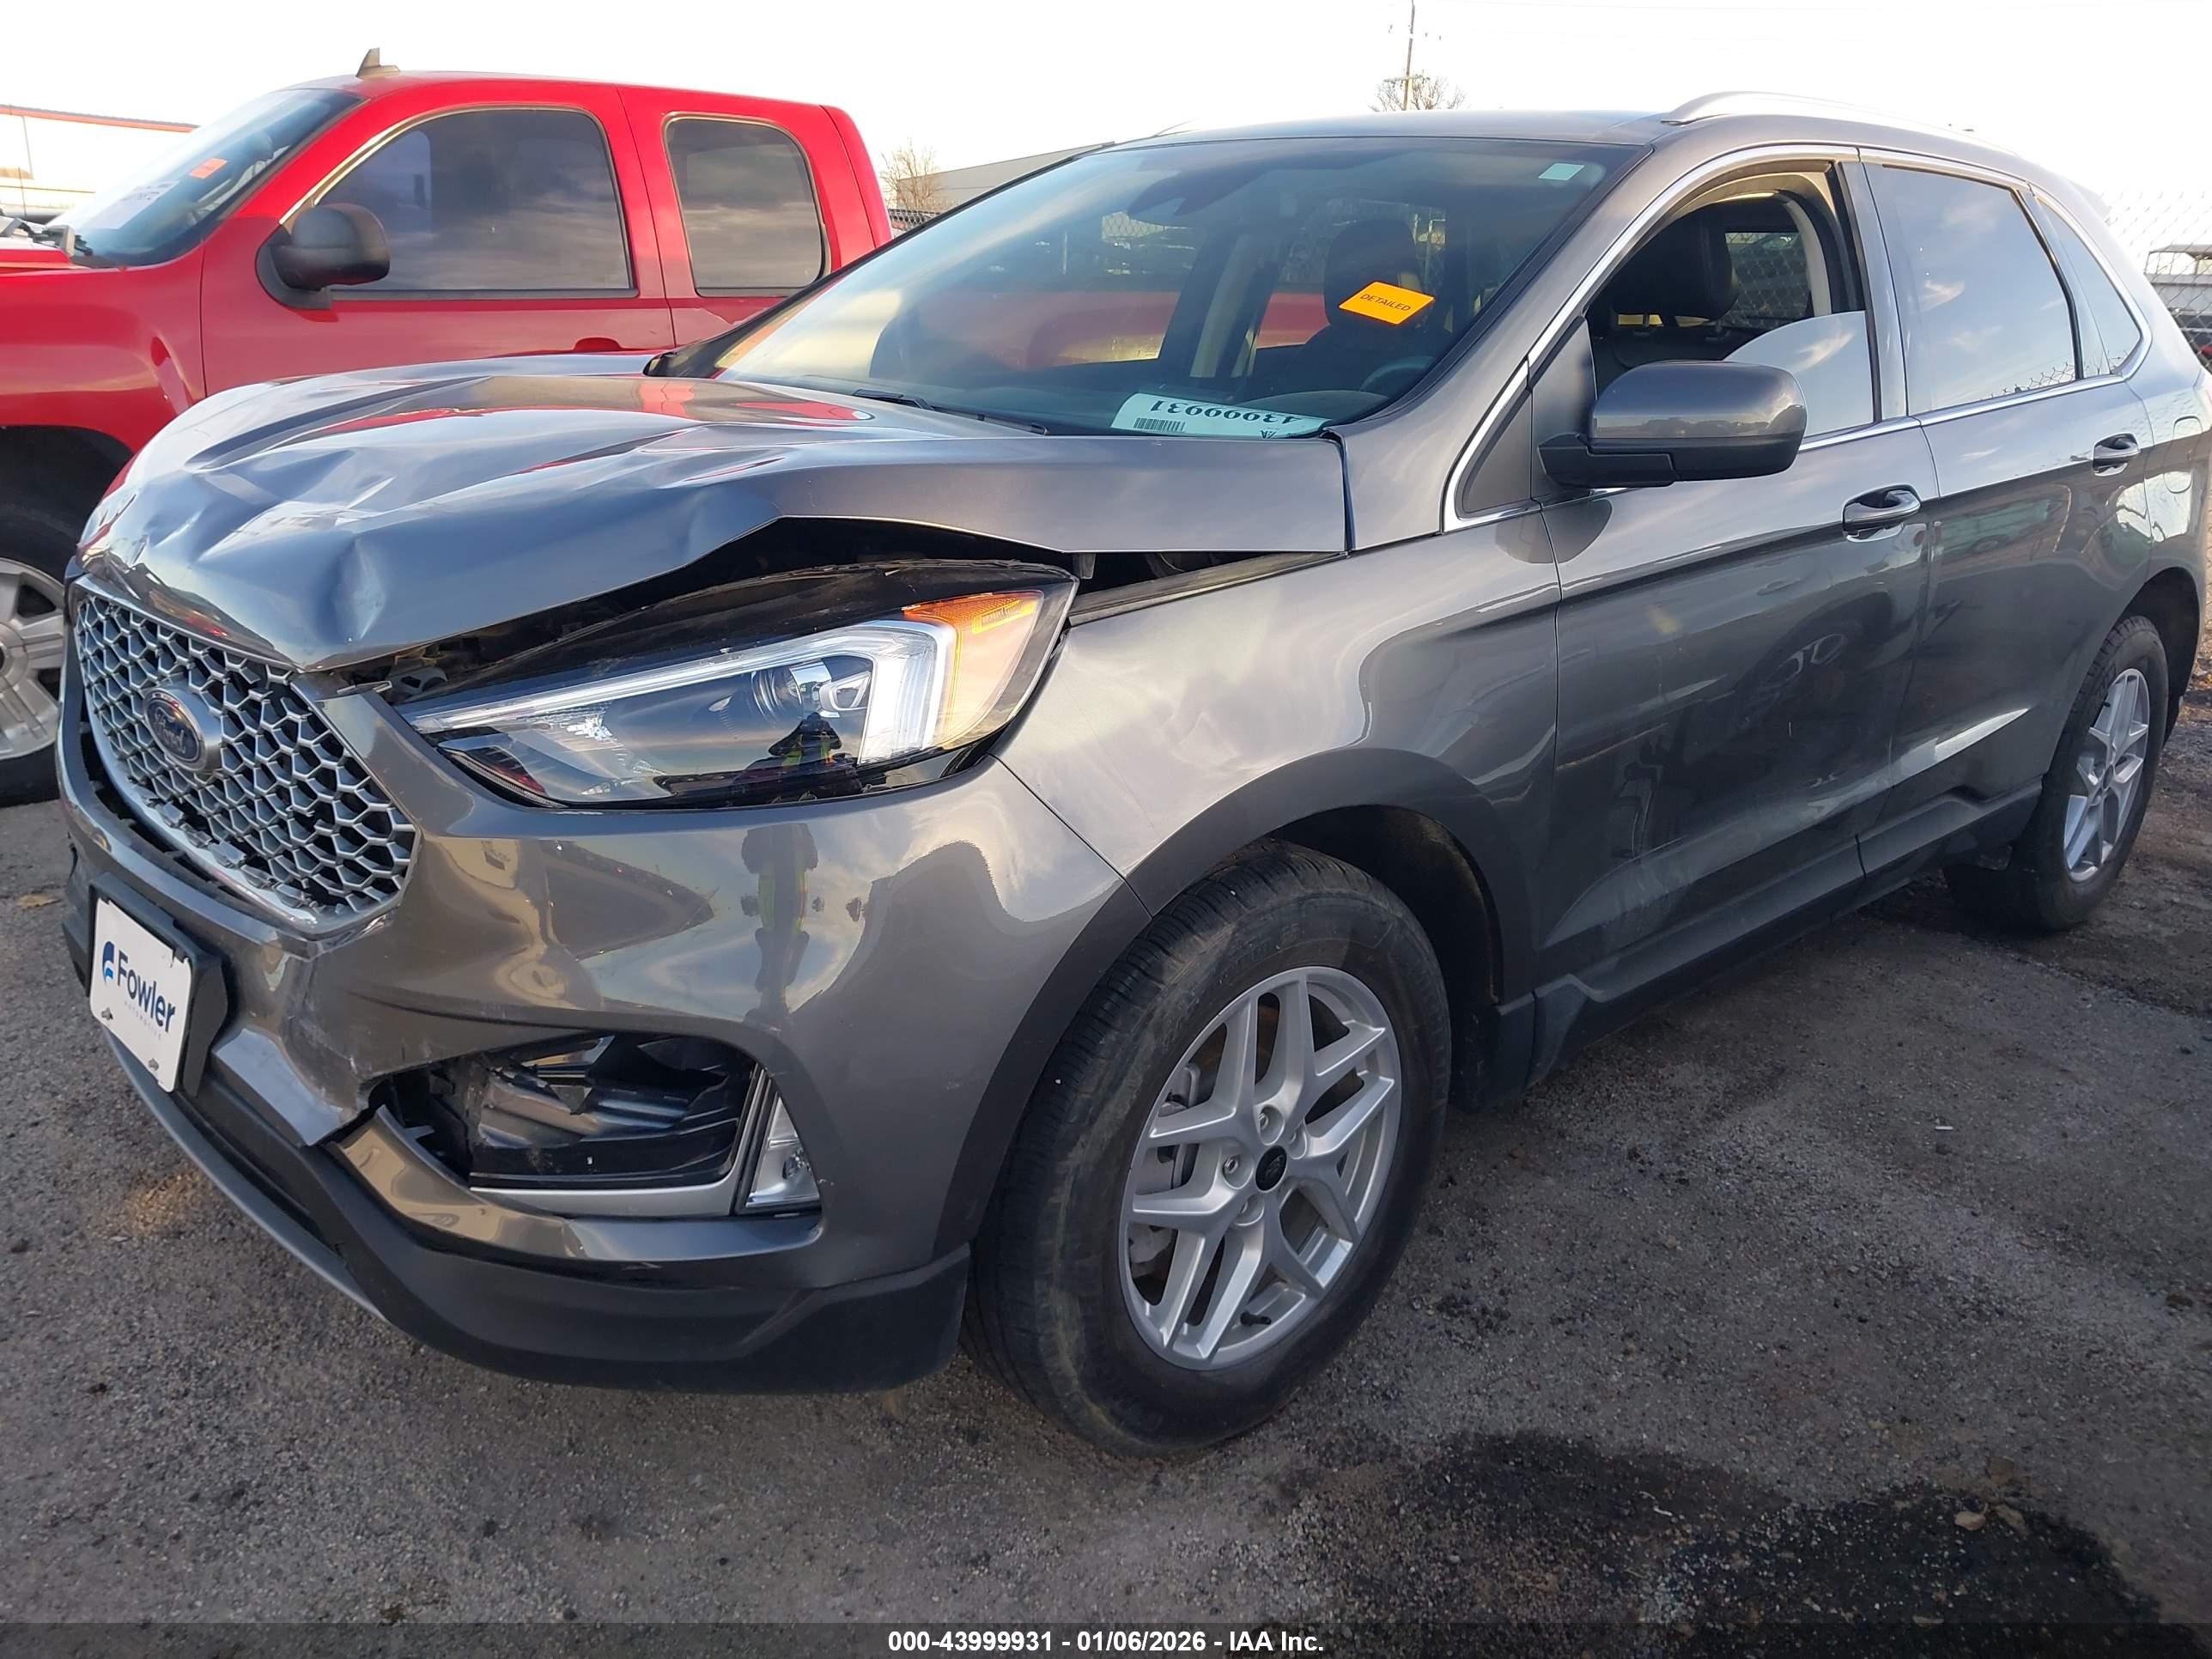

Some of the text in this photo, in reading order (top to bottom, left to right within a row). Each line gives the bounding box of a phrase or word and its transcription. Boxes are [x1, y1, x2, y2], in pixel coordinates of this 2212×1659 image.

[1360, 293, 1412, 312] DETAILED
[1150, 399, 1305, 425] 43999931
[117, 949, 176, 1033] Fowler
